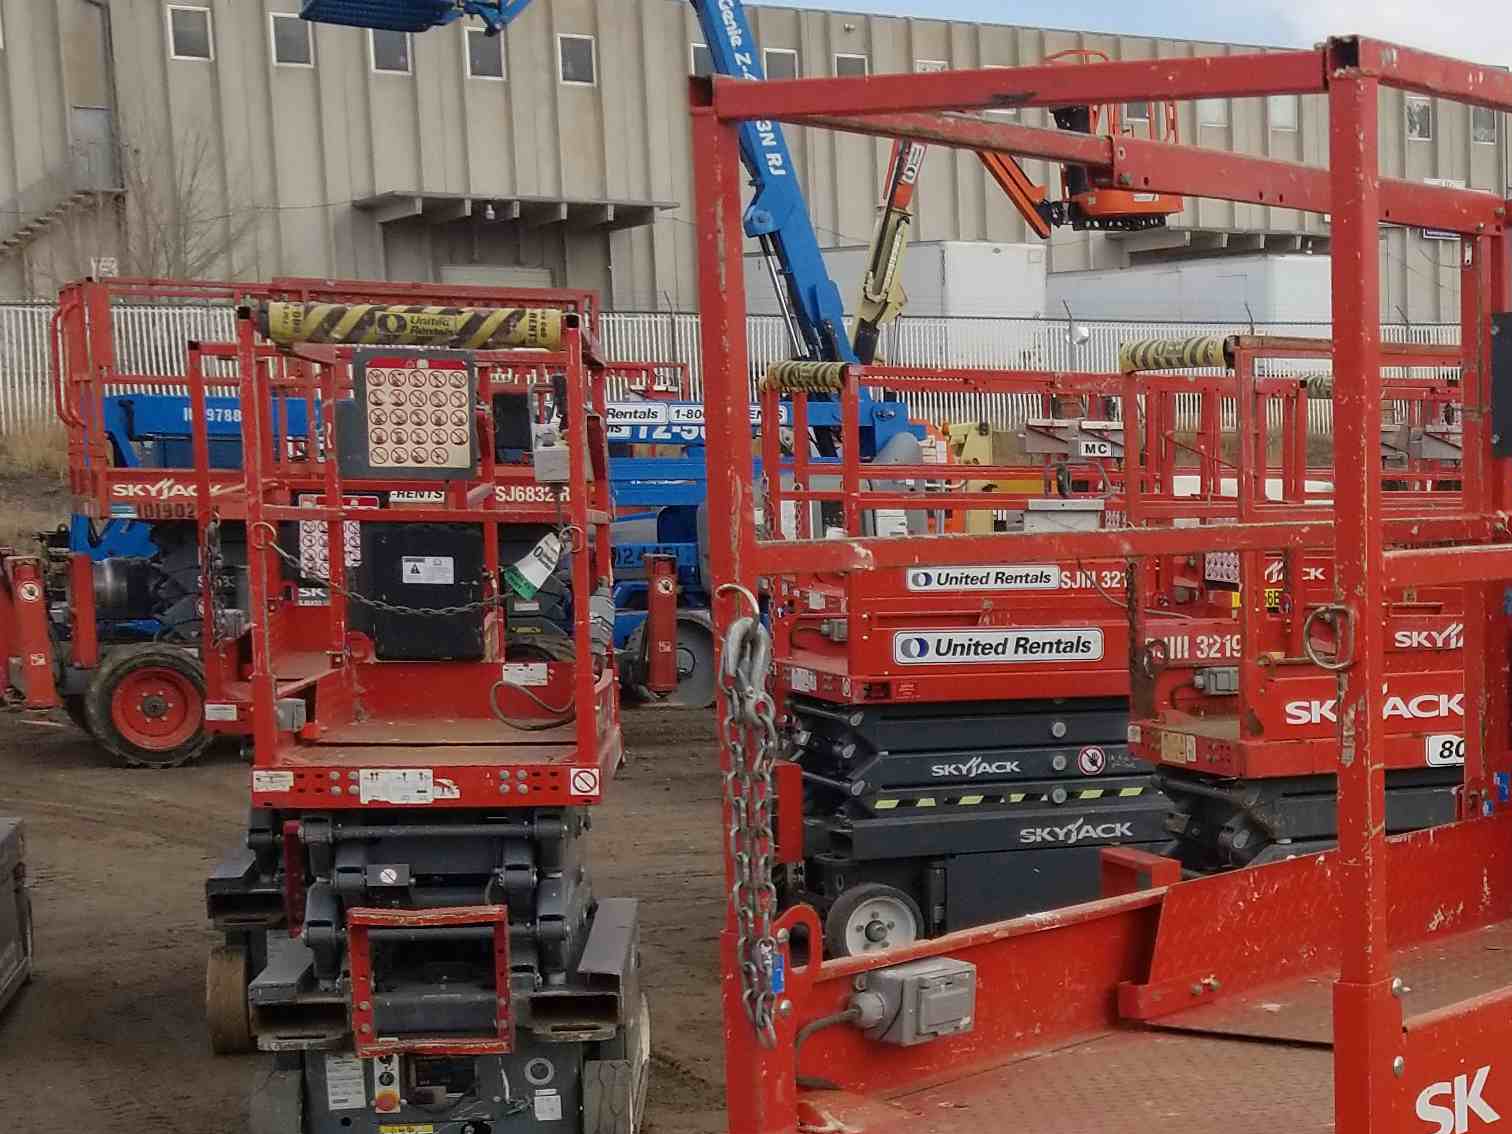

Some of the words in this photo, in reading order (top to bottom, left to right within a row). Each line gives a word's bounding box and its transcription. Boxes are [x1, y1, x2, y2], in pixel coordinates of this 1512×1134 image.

[765, 152, 787, 176] RJ
[1084, 443, 1108, 455] MC
[936, 572, 991, 588] United
[994, 570, 1052, 585] Rentals
[934, 637, 1010, 658] United
[1013, 635, 1092, 656] Rentals
[1195, 634, 1242, 659] 3219
[931, 756, 1021, 779] SKYJACK
[1019, 816, 1134, 844] SKYJACK
